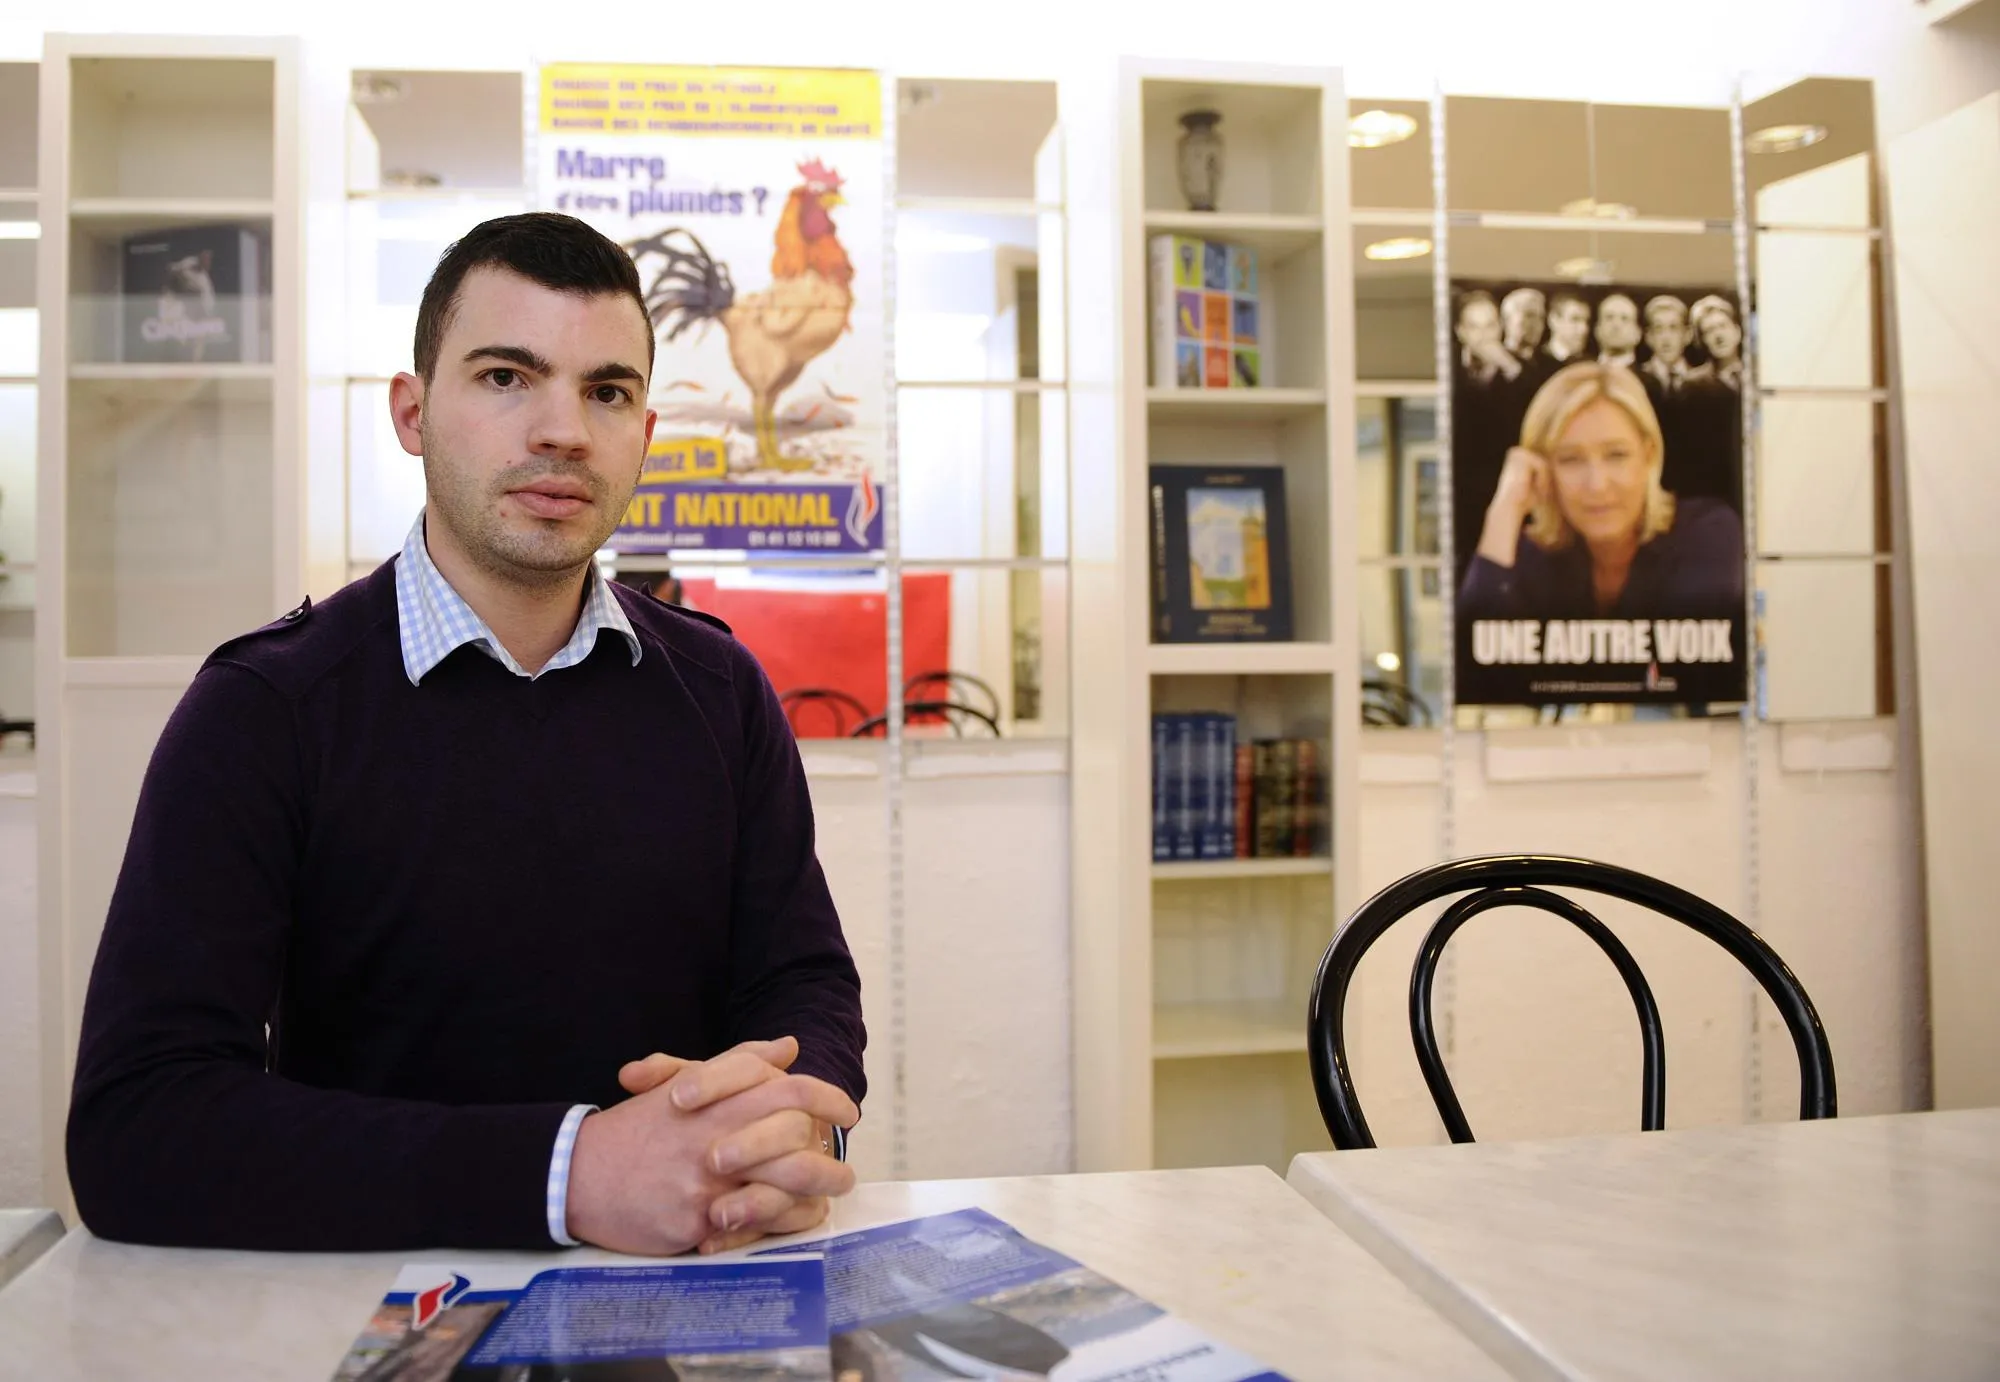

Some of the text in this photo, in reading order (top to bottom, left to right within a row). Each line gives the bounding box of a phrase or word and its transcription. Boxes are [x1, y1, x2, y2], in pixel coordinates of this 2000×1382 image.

[556, 149, 666, 180] Marre
[628, 186, 744, 217] plumés
[694, 447, 717, 468] le
[620, 493, 838, 526] NT NATIONAL
[1472, 619, 1733, 665] UNE AUTRE VOIX
